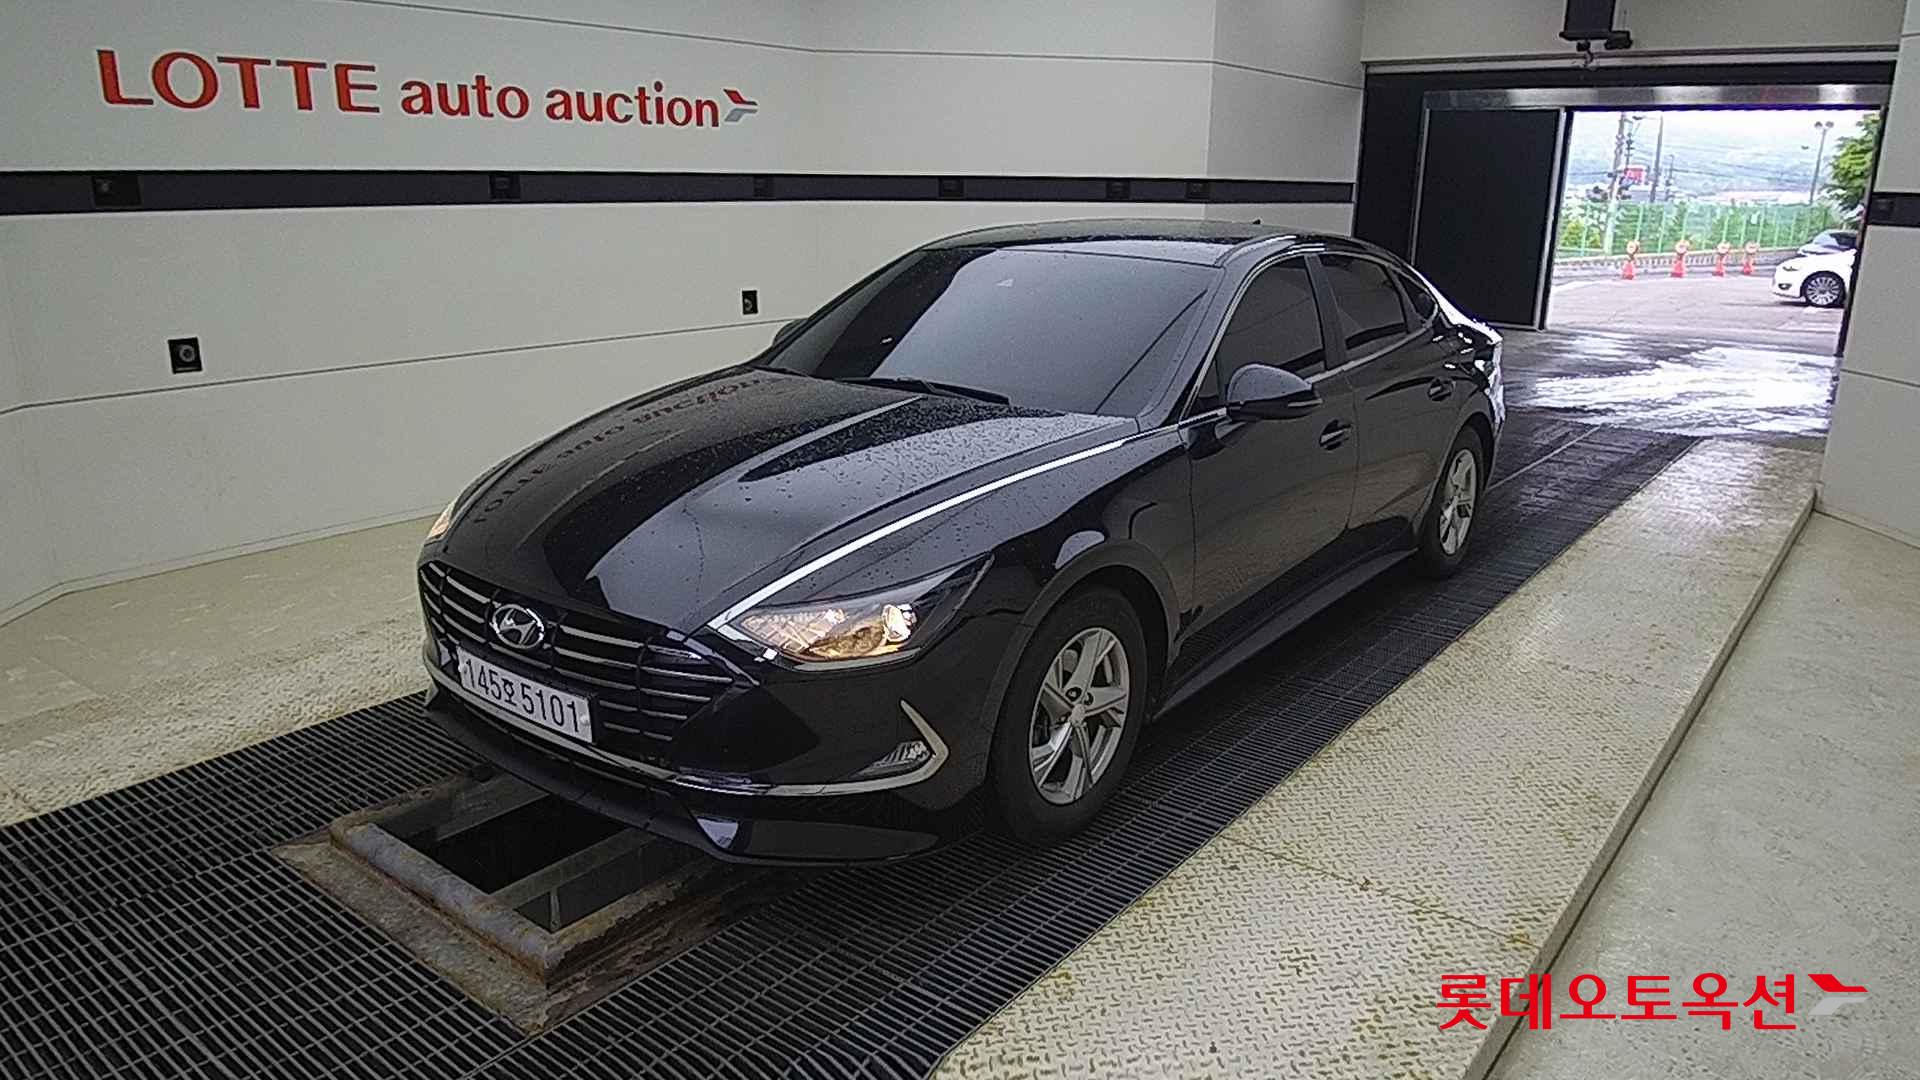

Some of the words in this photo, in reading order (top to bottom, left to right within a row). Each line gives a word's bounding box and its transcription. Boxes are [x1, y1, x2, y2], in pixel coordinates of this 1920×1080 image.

[96, 49, 380, 113] LOTTE
[401, 75, 529, 118] auto
[545, 80, 720, 127] auction
